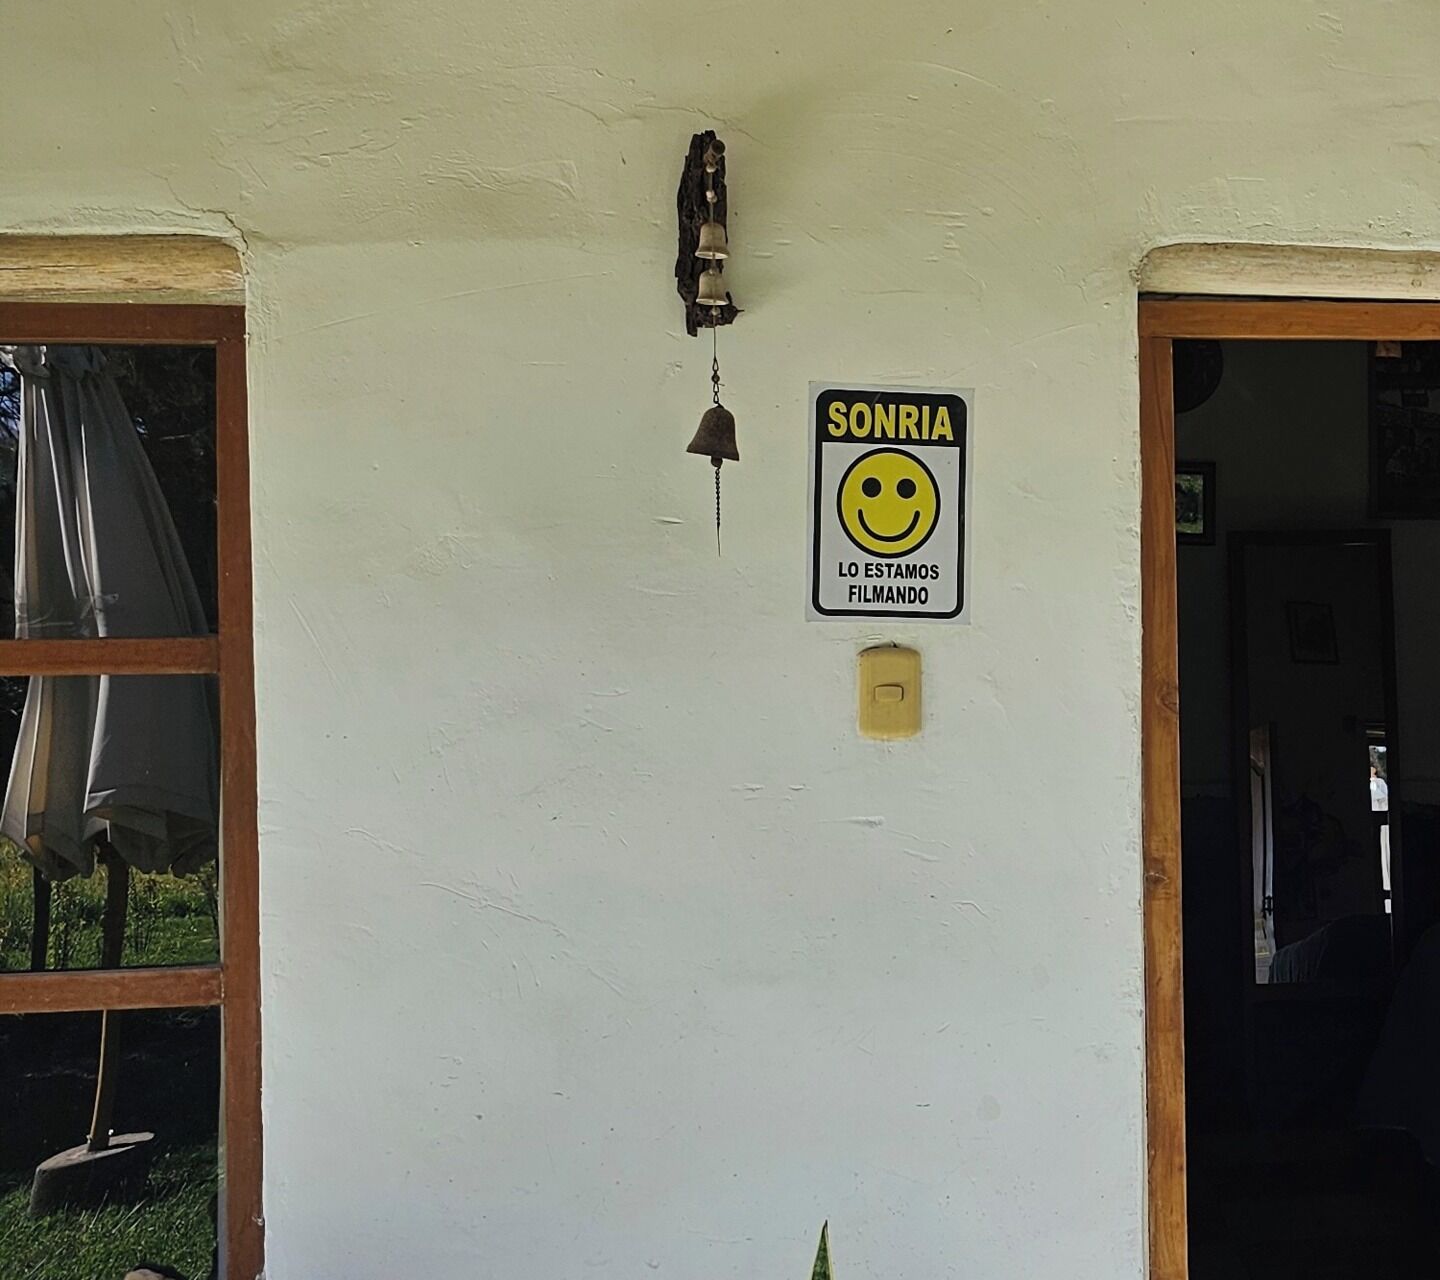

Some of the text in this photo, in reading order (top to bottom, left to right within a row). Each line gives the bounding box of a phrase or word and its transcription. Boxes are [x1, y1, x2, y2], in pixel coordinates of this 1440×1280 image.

[827, 401, 954, 441] SONRIA
[838, 562, 940, 580] LO ESTAMOS
[848, 585, 929, 605] FILMANDO
